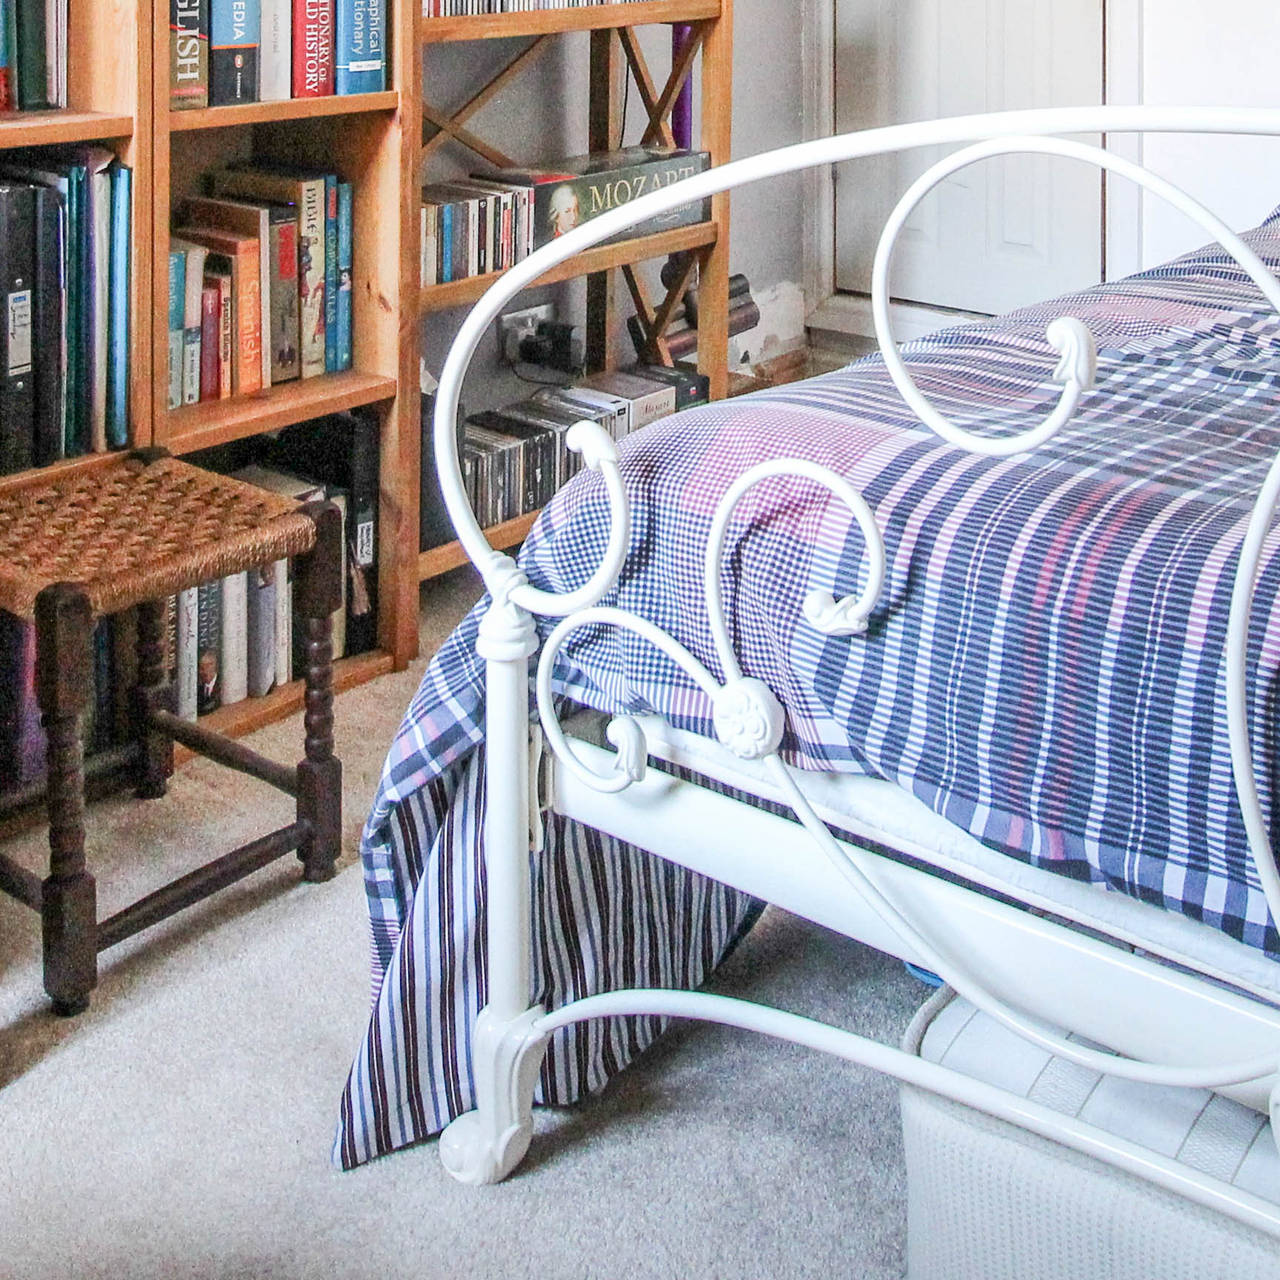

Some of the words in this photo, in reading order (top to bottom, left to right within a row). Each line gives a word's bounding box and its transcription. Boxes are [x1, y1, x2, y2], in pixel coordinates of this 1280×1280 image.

[305, 24, 318, 93] HISTORY
[320, 67, 327, 82] OF
[327, 229, 335, 281] COMPACT
[223, 297, 231, 331] Spanish
[243, 279, 260, 363] Spanish
[326, 285, 335, 323] ATLAS
